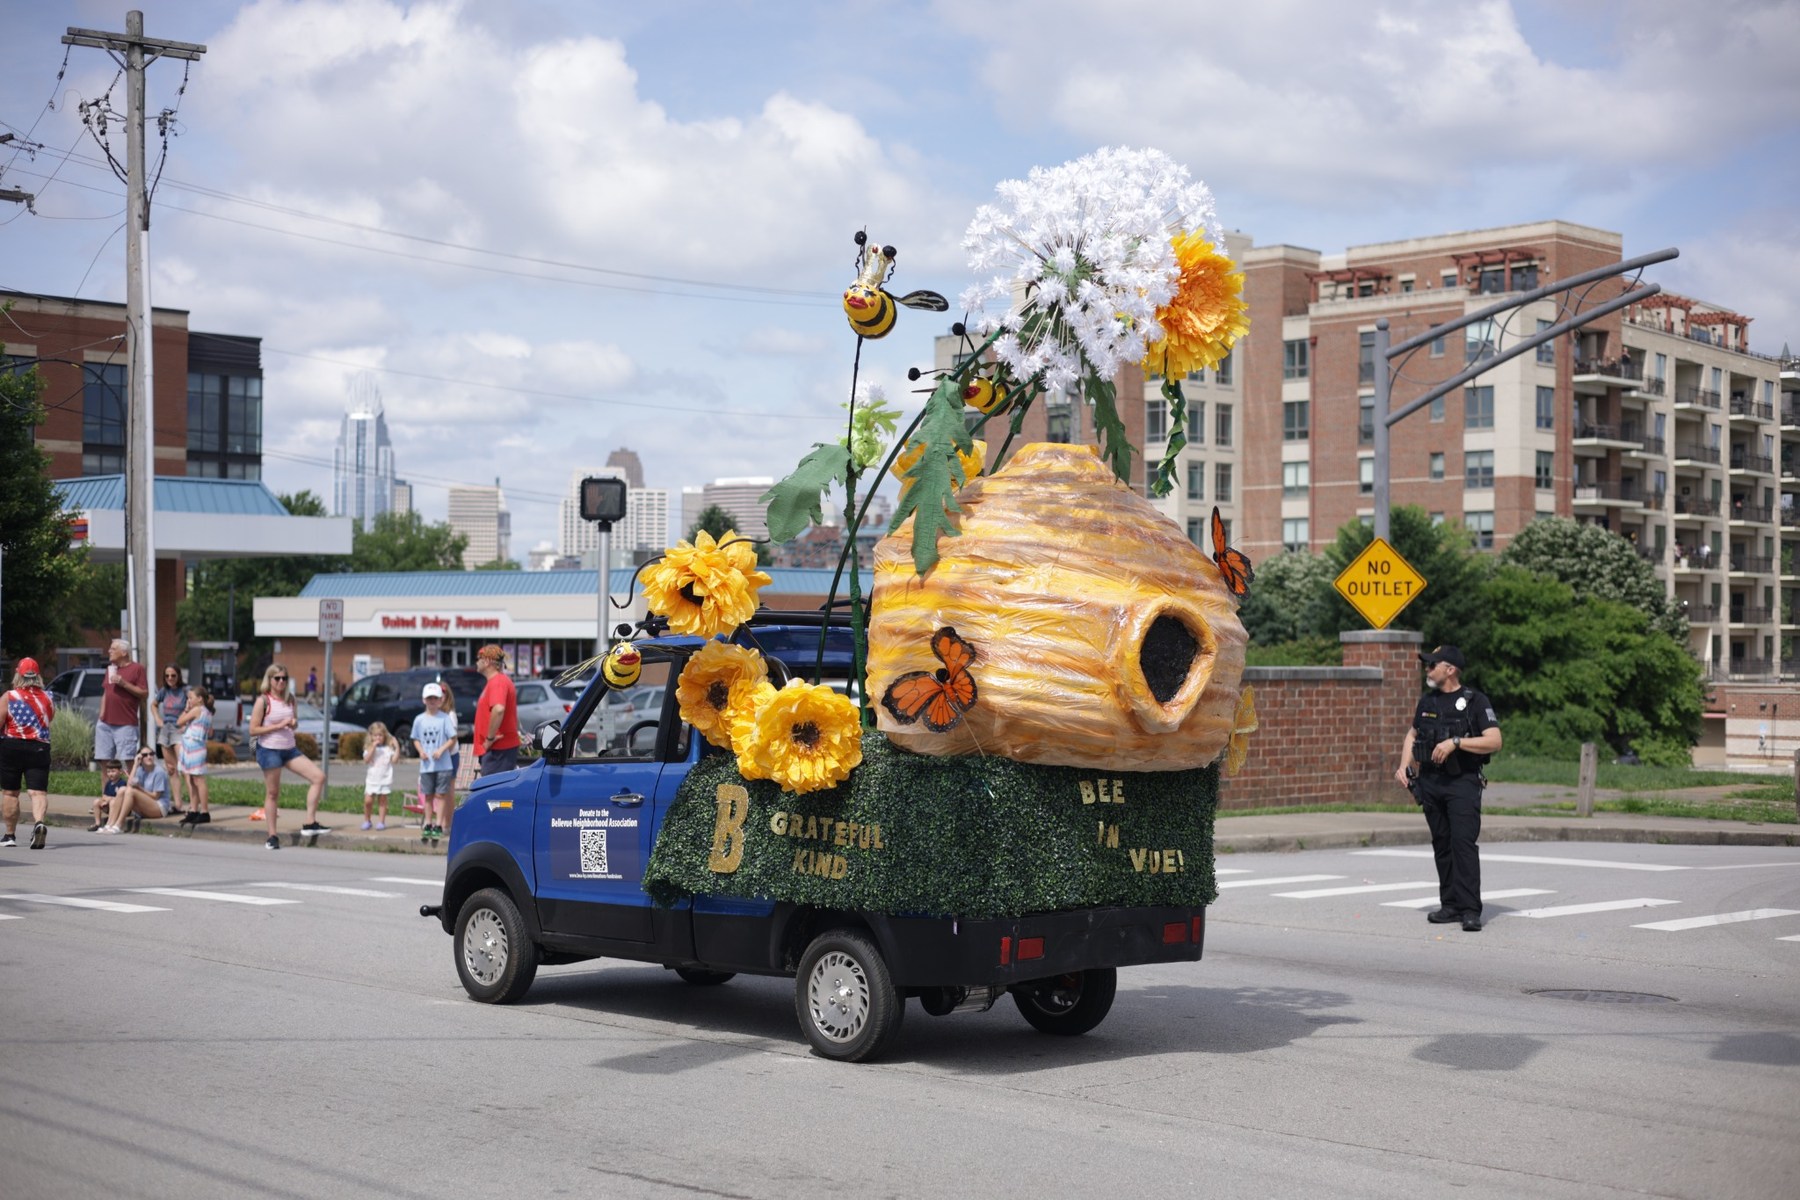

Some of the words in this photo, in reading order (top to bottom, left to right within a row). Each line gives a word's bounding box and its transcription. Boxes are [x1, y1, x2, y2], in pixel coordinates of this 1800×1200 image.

[1368, 560, 1391, 575] NO
[1347, 581, 1413, 596] OUTLET
[326, 602, 337, 610] NO
[382, 616, 417, 629] United
[1079, 778, 1125, 805] BEE
[579, 809, 595, 817] Donate
[596, 809, 601, 817] to
[601, 809, 609, 817] the
[551, 818, 572, 828] Bellevue
[573, 818, 609, 830] Neighborhood
[609, 818, 638, 828] Association
[708, 783, 750, 874] B
[770, 811, 884, 850] GRATEFUL
[1097, 820, 1120, 849] IN
[792, 849, 848, 880] KIND
[1128, 847, 1185, 875] VUE!
